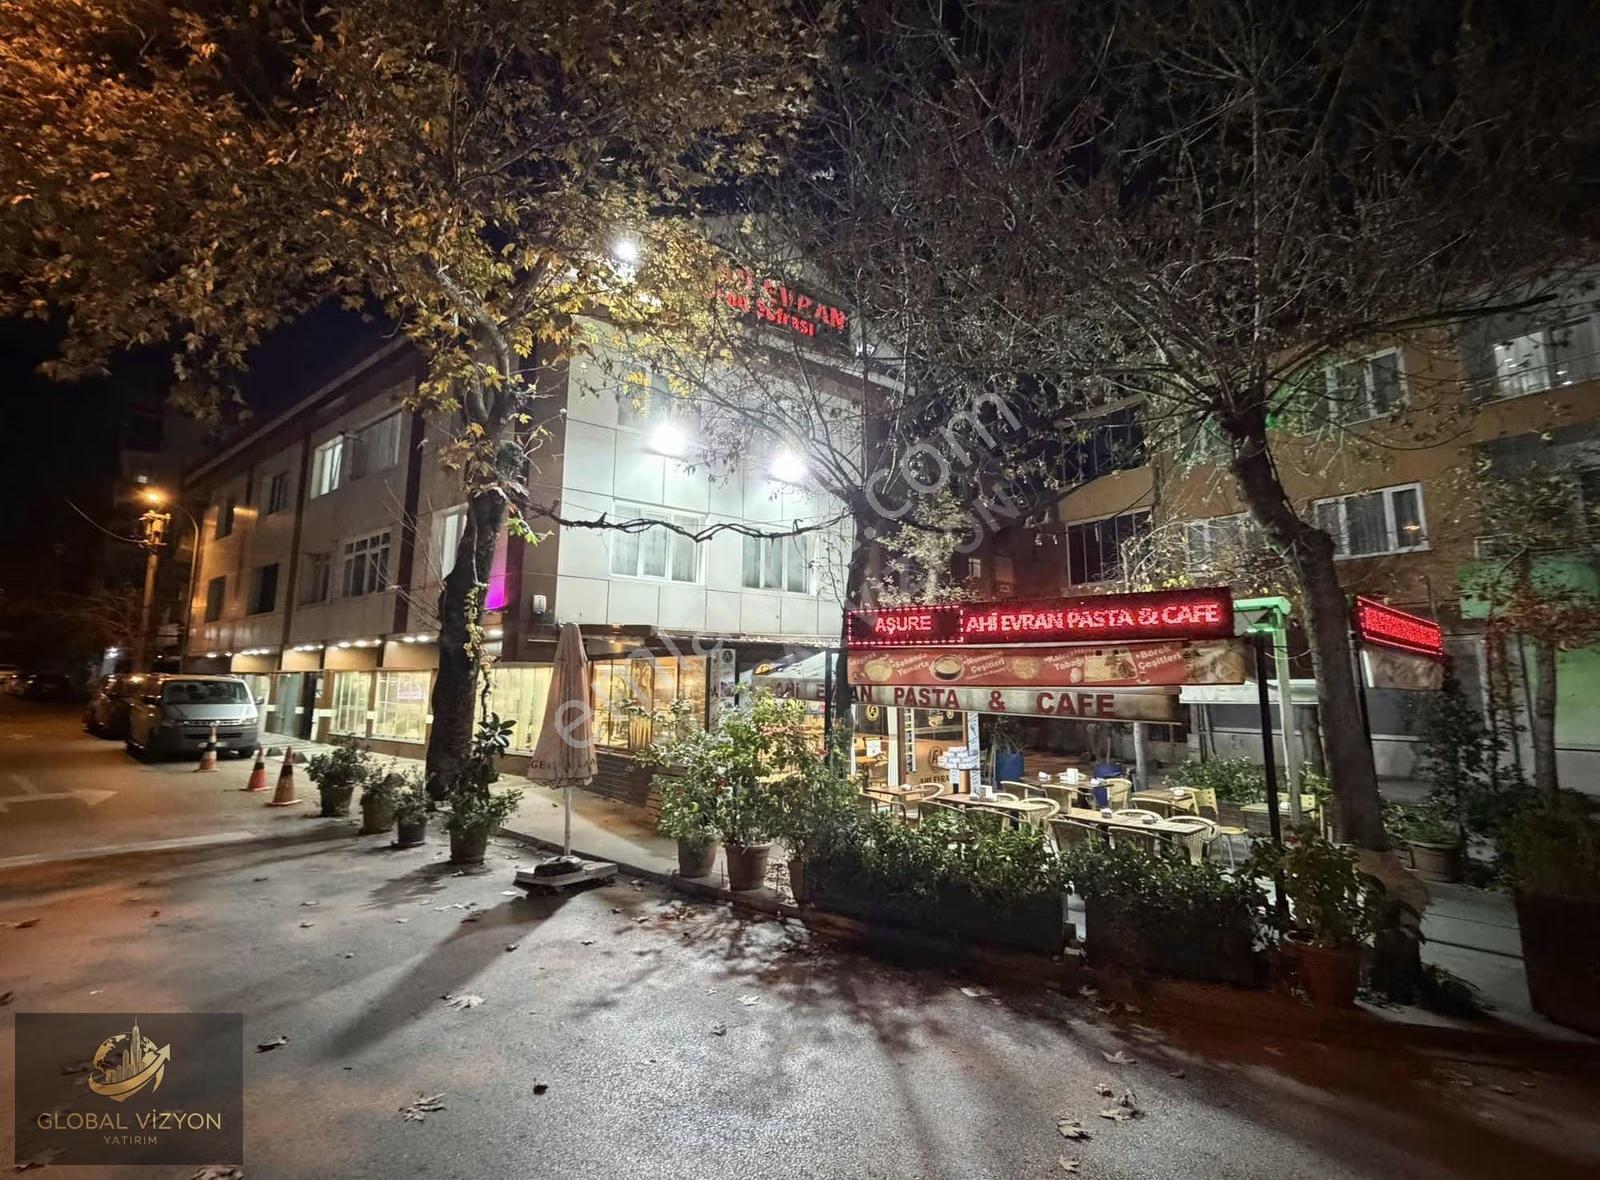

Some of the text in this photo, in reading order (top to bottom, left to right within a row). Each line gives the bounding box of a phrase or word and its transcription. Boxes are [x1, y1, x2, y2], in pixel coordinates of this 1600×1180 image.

[875, 615, 932, 635] AŞURE
[966, 603, 1220, 633] AHİ EVRAN PASTA & CAFE
[893, 687, 960, 710] PASTA
[988, 690, 1006, 713] &
[1036, 691, 1115, 718] CAFE
